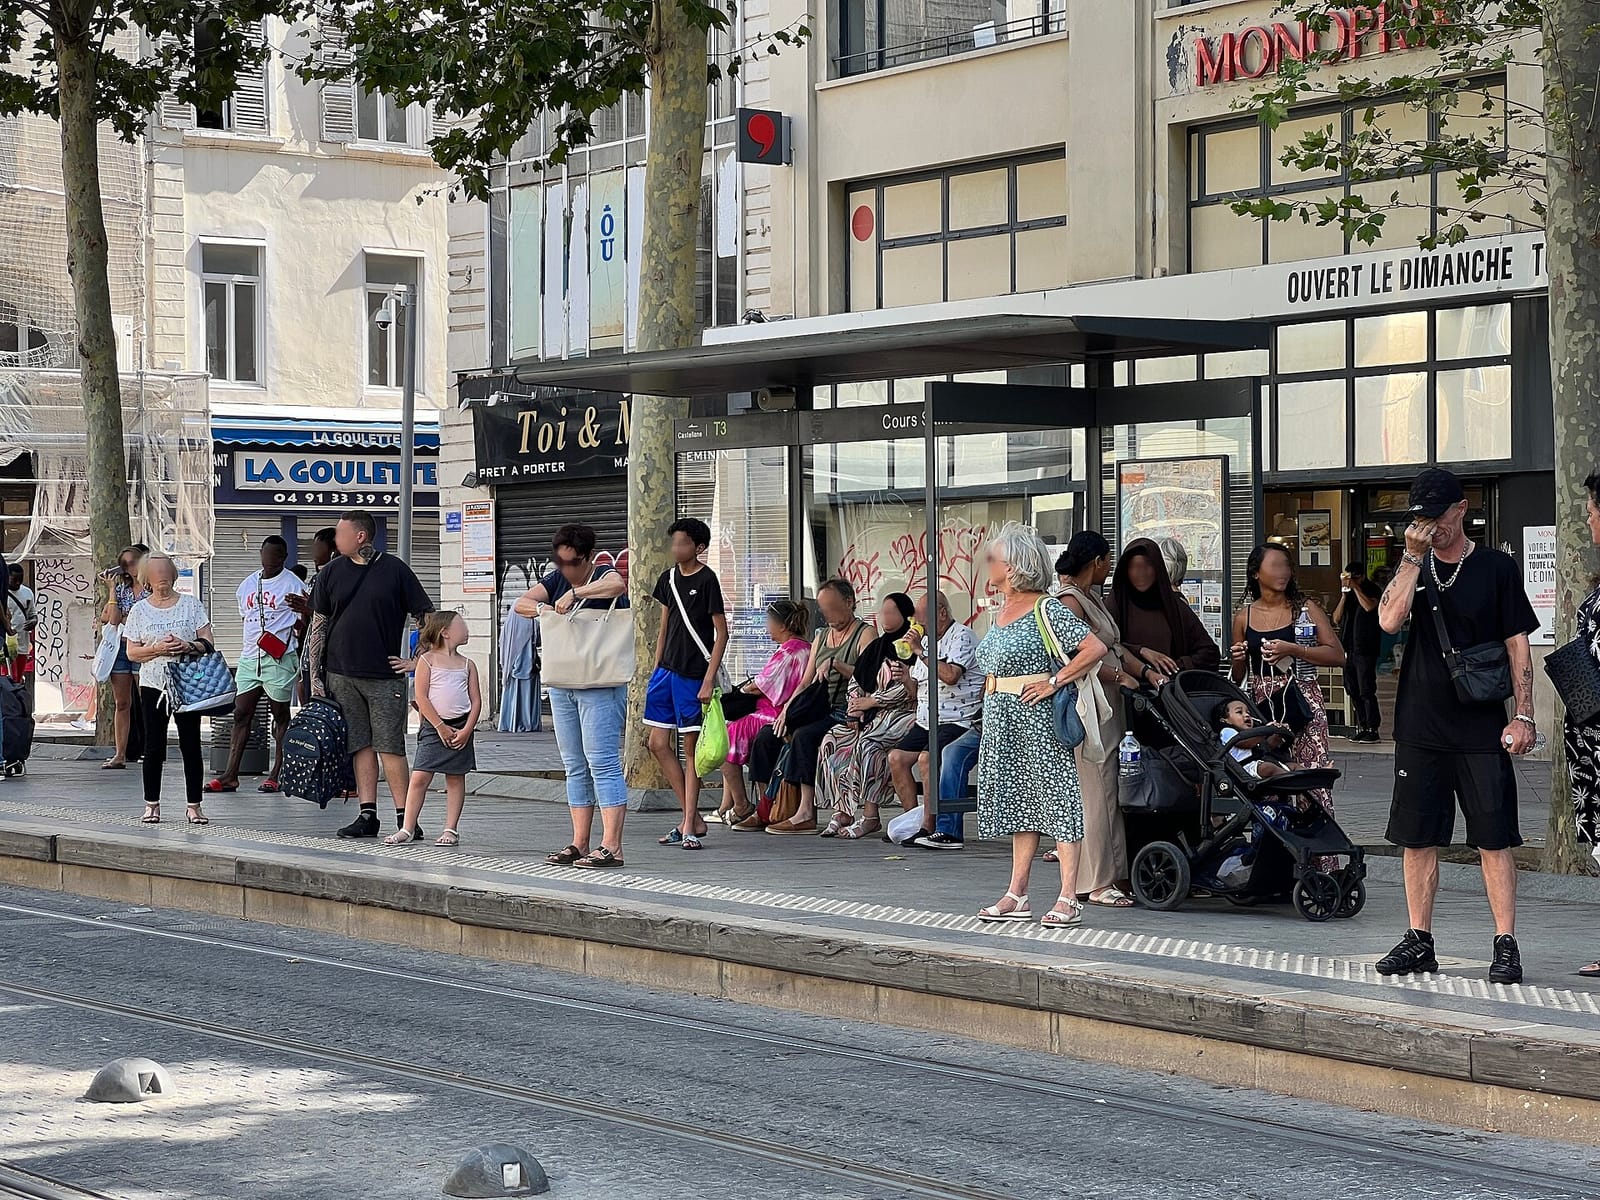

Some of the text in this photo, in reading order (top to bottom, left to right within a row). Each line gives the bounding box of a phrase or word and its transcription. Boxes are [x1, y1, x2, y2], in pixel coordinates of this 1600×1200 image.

[1287, 243, 1548, 303] OUVERT LE DIMANCHE T
[713, 421, 727, 436] T3
[882, 413, 918, 430] Cours
[312, 431, 402, 444] LA GOULETTE
[517, 406, 568, 454] Toi
[578, 406, 601, 449] &
[244, 458, 438, 486] LA GOULETTE
[479, 461, 566, 478] PRET A PORTER
[273, 493, 298, 503] 04
[305, 493, 324, 504] 91
[331, 493, 349, 504] 33
[356, 493, 376, 504] 39
[1528, 542, 1547, 552] VOTRE
[1528, 561, 1546, 570] TOUTE
[1528, 571, 1538, 583] LE
[246, 591, 279, 611] NSA
